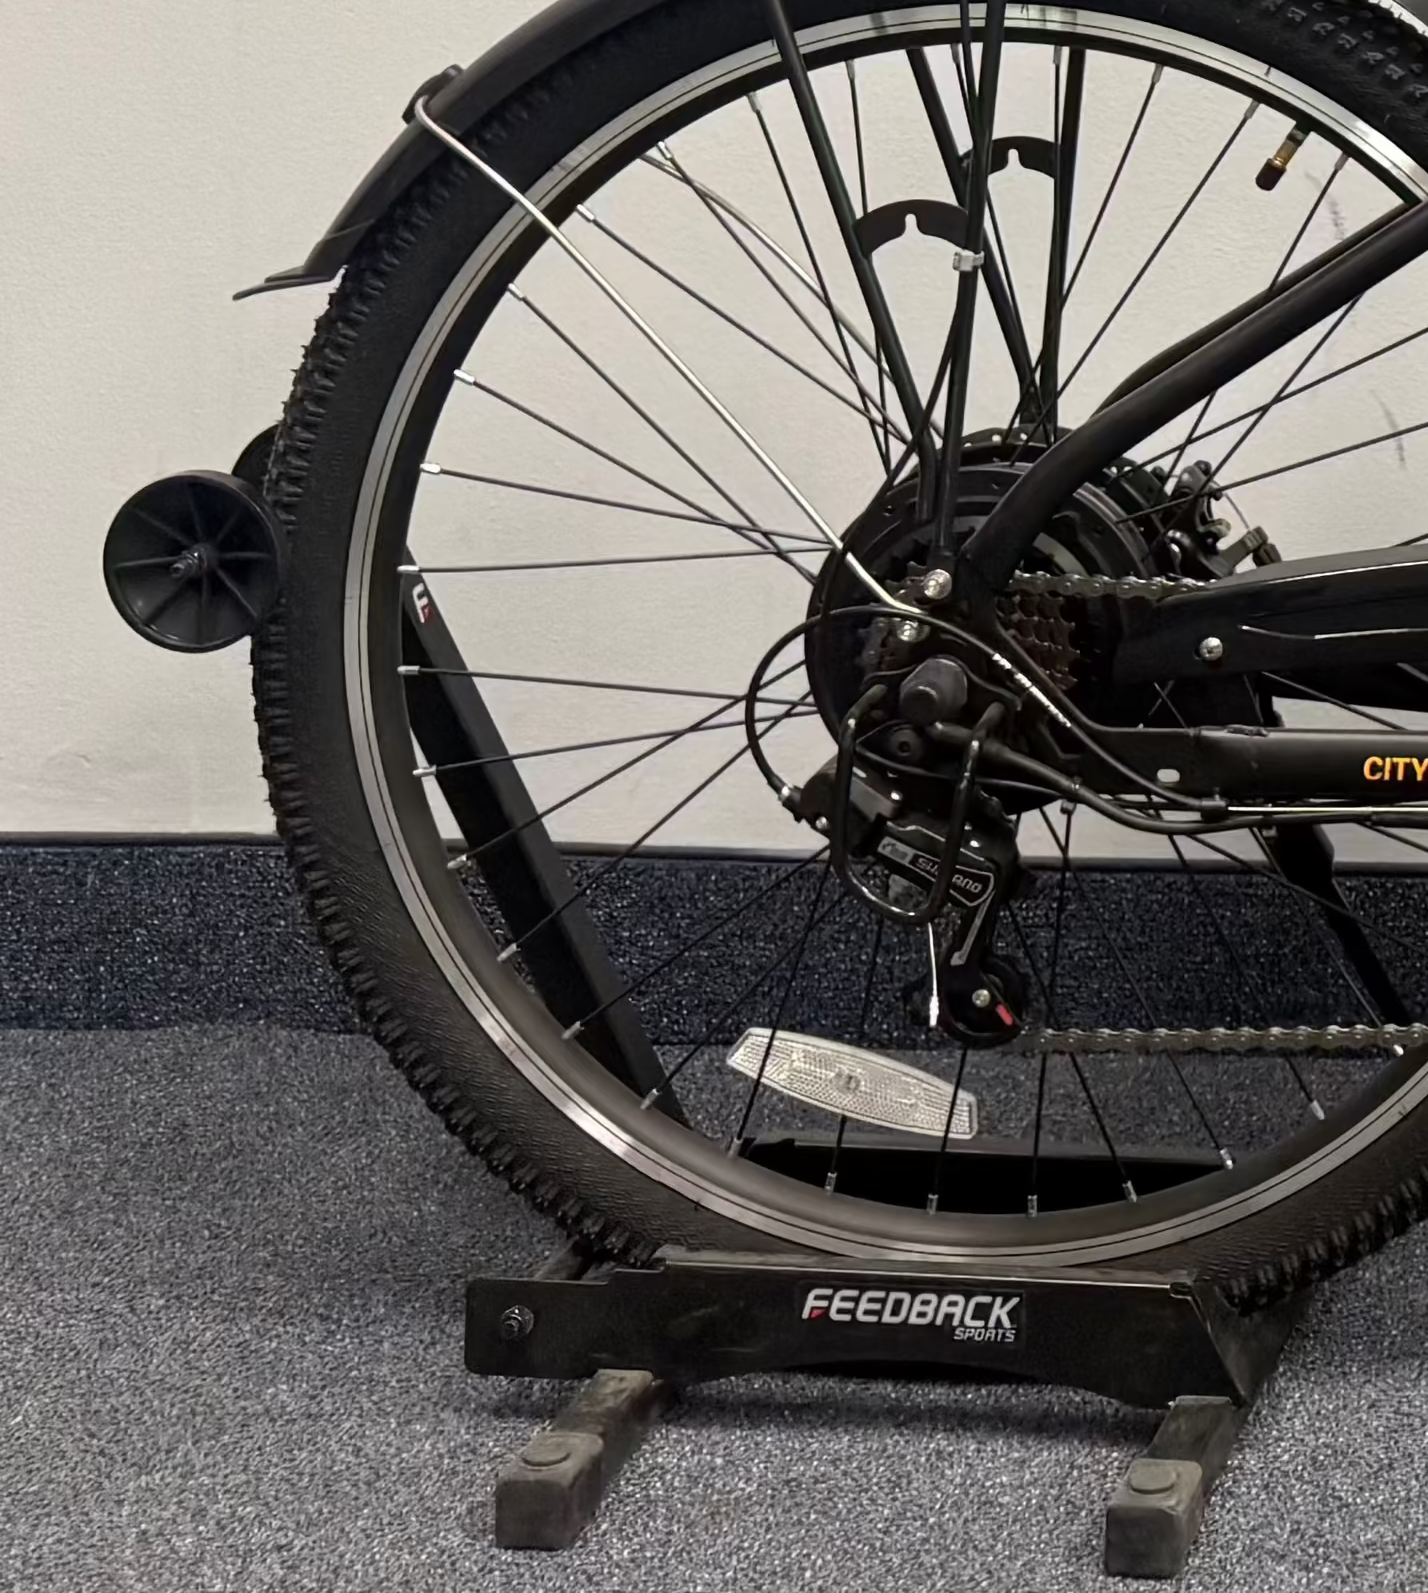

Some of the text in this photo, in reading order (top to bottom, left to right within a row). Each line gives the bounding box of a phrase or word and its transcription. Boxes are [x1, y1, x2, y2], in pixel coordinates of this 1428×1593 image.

[914, 856, 983, 894] SHANO
[802, 1288, 1020, 1328] FEEDBACK
[953, 1327, 1017, 1343] SPORTS
